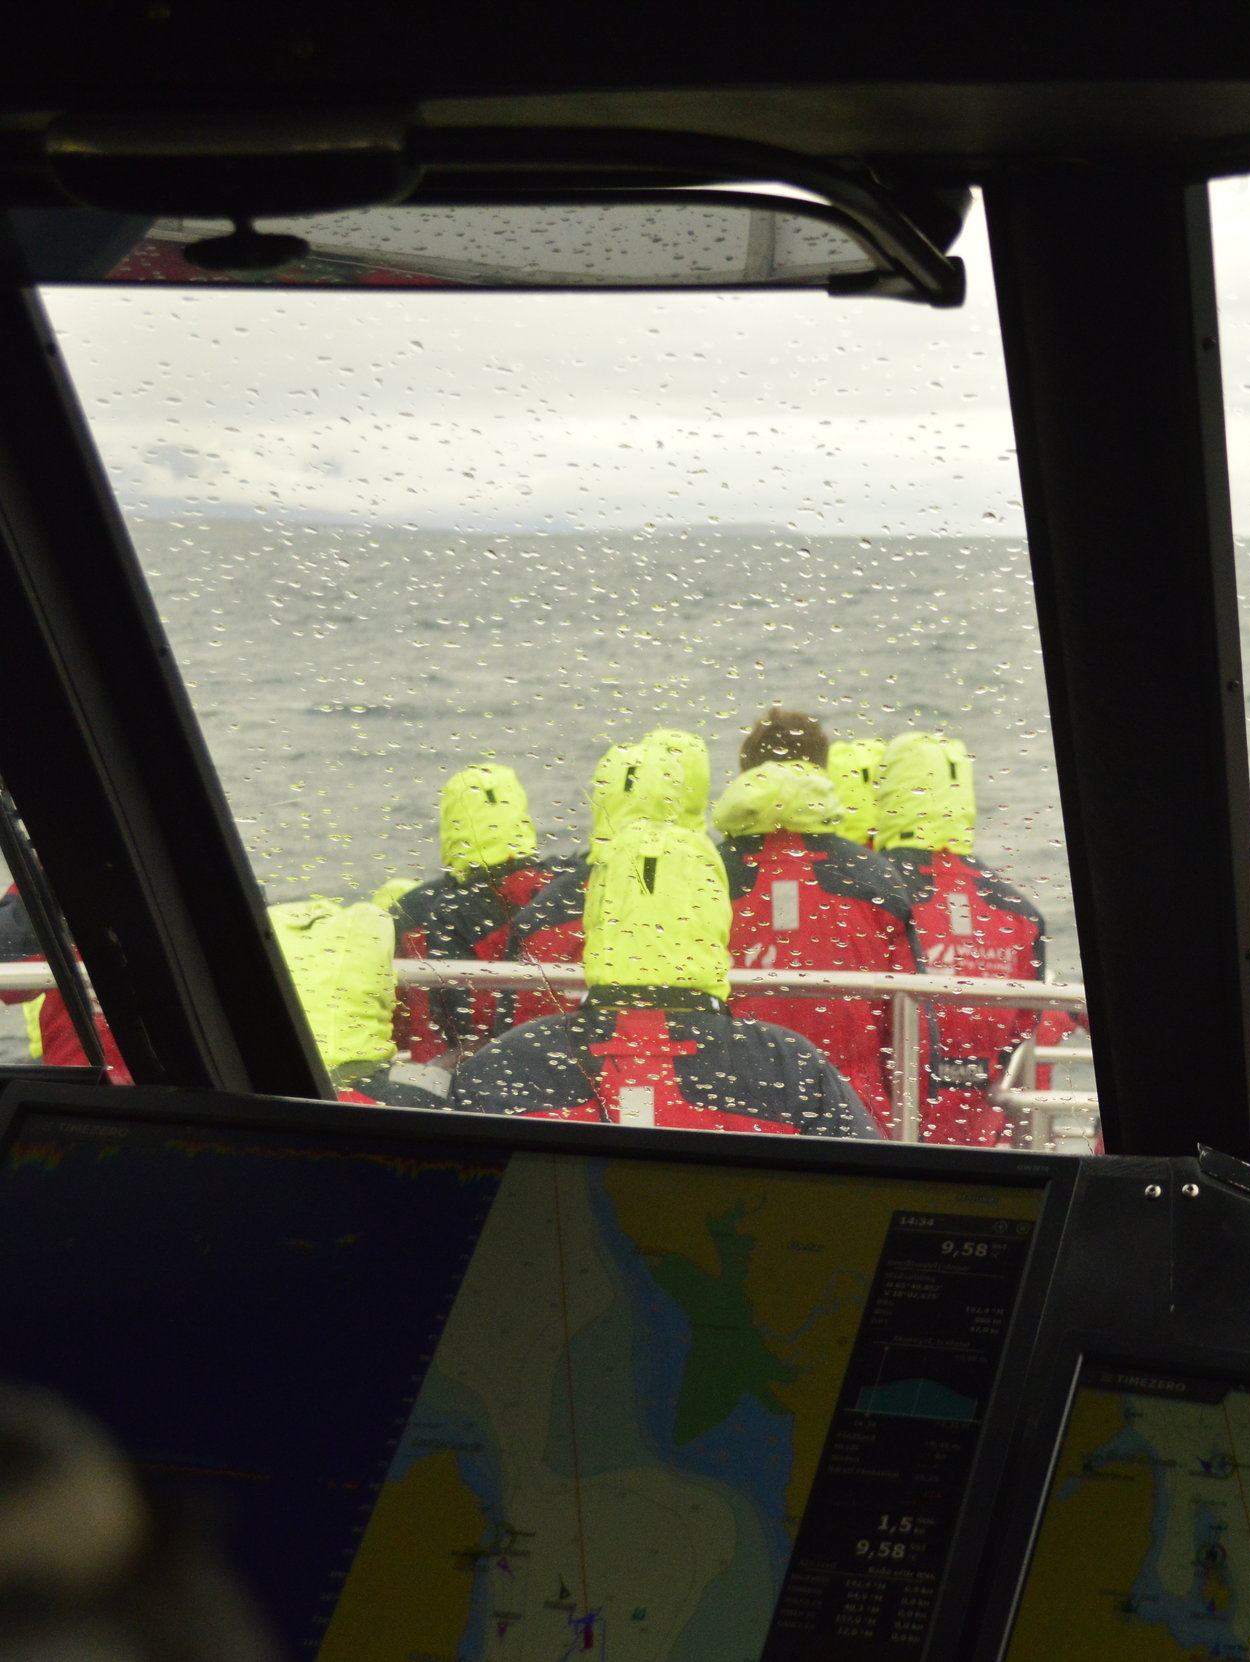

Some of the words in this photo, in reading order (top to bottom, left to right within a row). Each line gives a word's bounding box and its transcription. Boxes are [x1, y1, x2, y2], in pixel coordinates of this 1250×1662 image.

[58, 1122, 129, 1138] TIMEZERO
[899, 1216, 935, 1227] 14:34
[941, 1240, 989, 1259] 9,58
[1117, 1374, 1187, 1392] TIMEZERO
[877, 1514, 914, 1535] 1,5
[855, 1539, 907, 1560] 9,58
